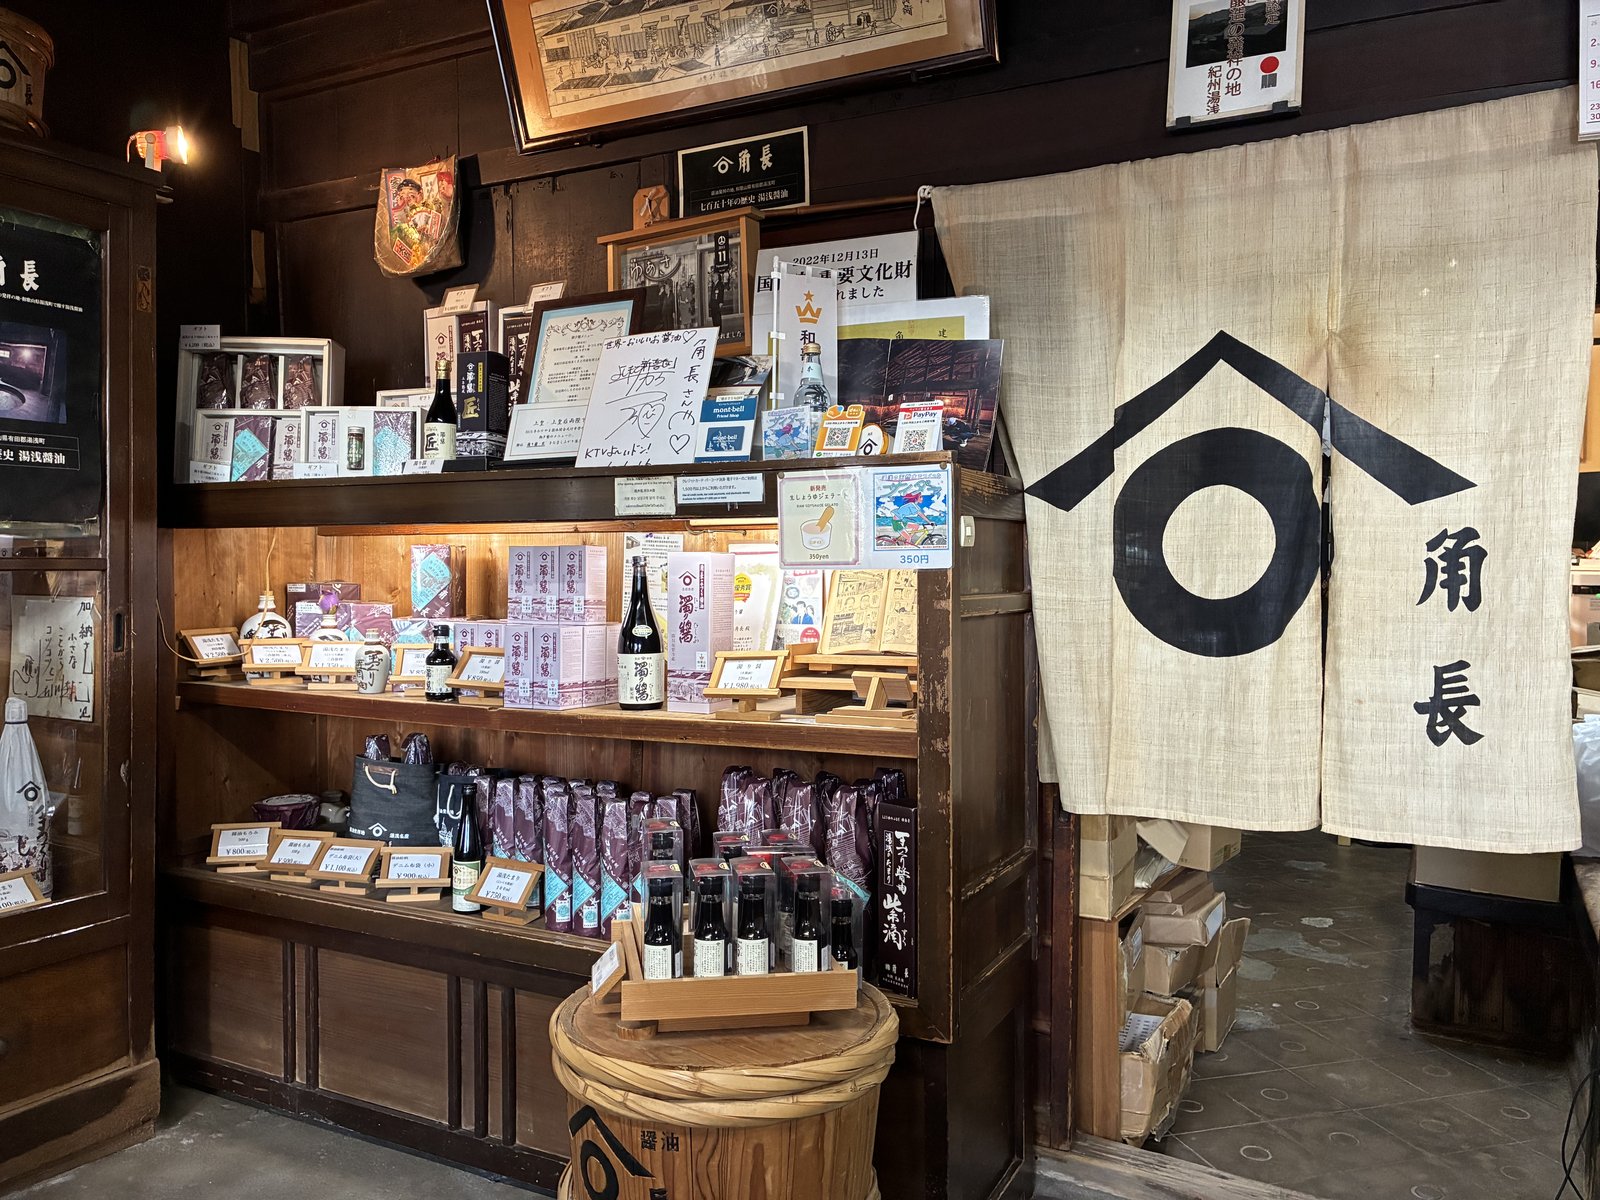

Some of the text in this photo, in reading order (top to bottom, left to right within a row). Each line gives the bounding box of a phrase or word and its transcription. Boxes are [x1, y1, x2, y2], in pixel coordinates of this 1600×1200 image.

[1206, 65, 1222, 115] 紀州湯浅
[738, 144, 774, 174] 角長
[792, 247, 880, 267] 2022年12月13日
[913, 411, 937, 419] PayPay
[18, 449, 66, 465] 湯浅醤油
[808, 552, 830, 561] 350yen
[899, 554, 930, 564] 350円
[1413, 526, 1489, 748] 角長
[226, 848, 245, 856] ¥800
[324, 863, 346, 872] ¥1,100
[640, 1130, 681, 1152] 醤油
